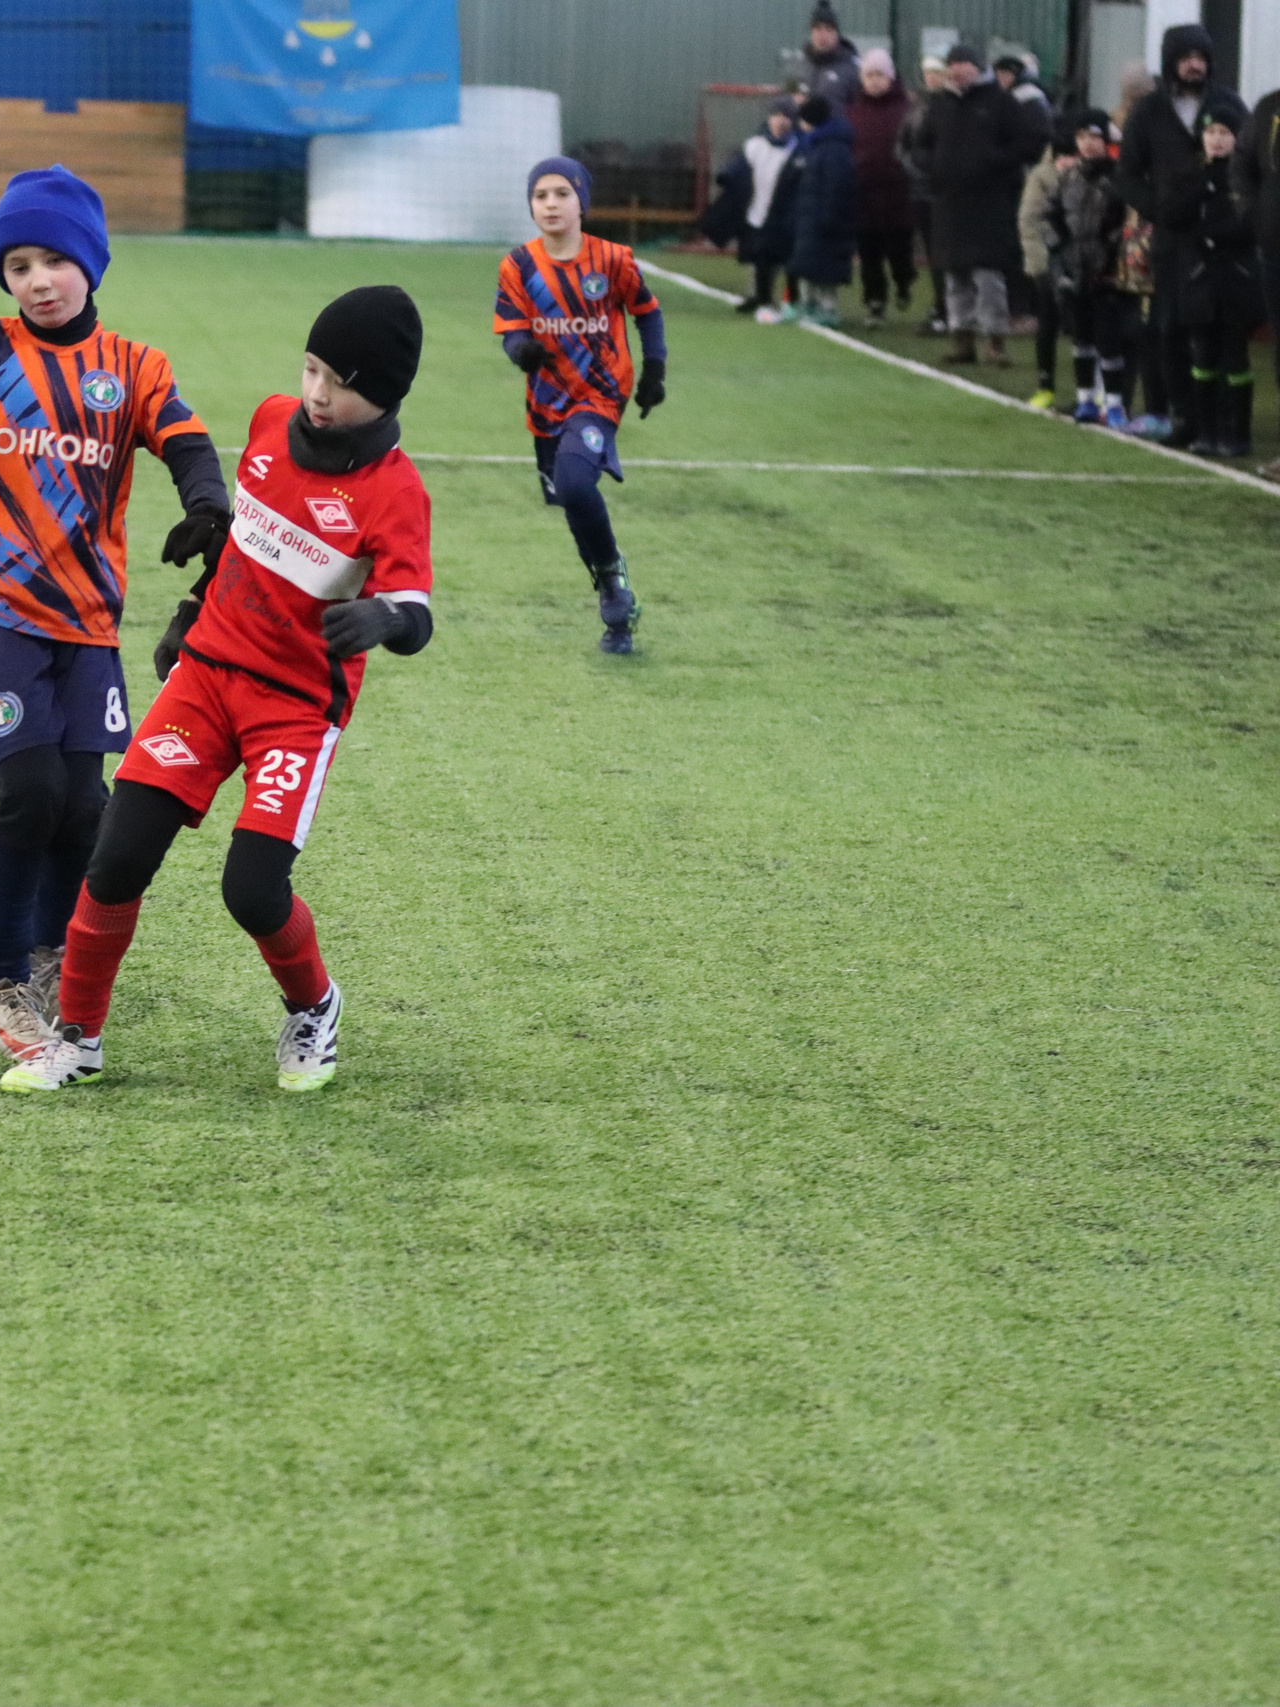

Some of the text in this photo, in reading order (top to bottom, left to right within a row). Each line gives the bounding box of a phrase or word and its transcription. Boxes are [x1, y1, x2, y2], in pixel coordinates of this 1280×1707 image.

[531, 314, 608, 335] ОНКОВО
[235, 496, 330, 567] ПАРТАК ЮНИОР
[243, 531, 281, 561] ДУБНА
[105, 686, 127, 733] 8
[256, 749, 307, 791] 23
